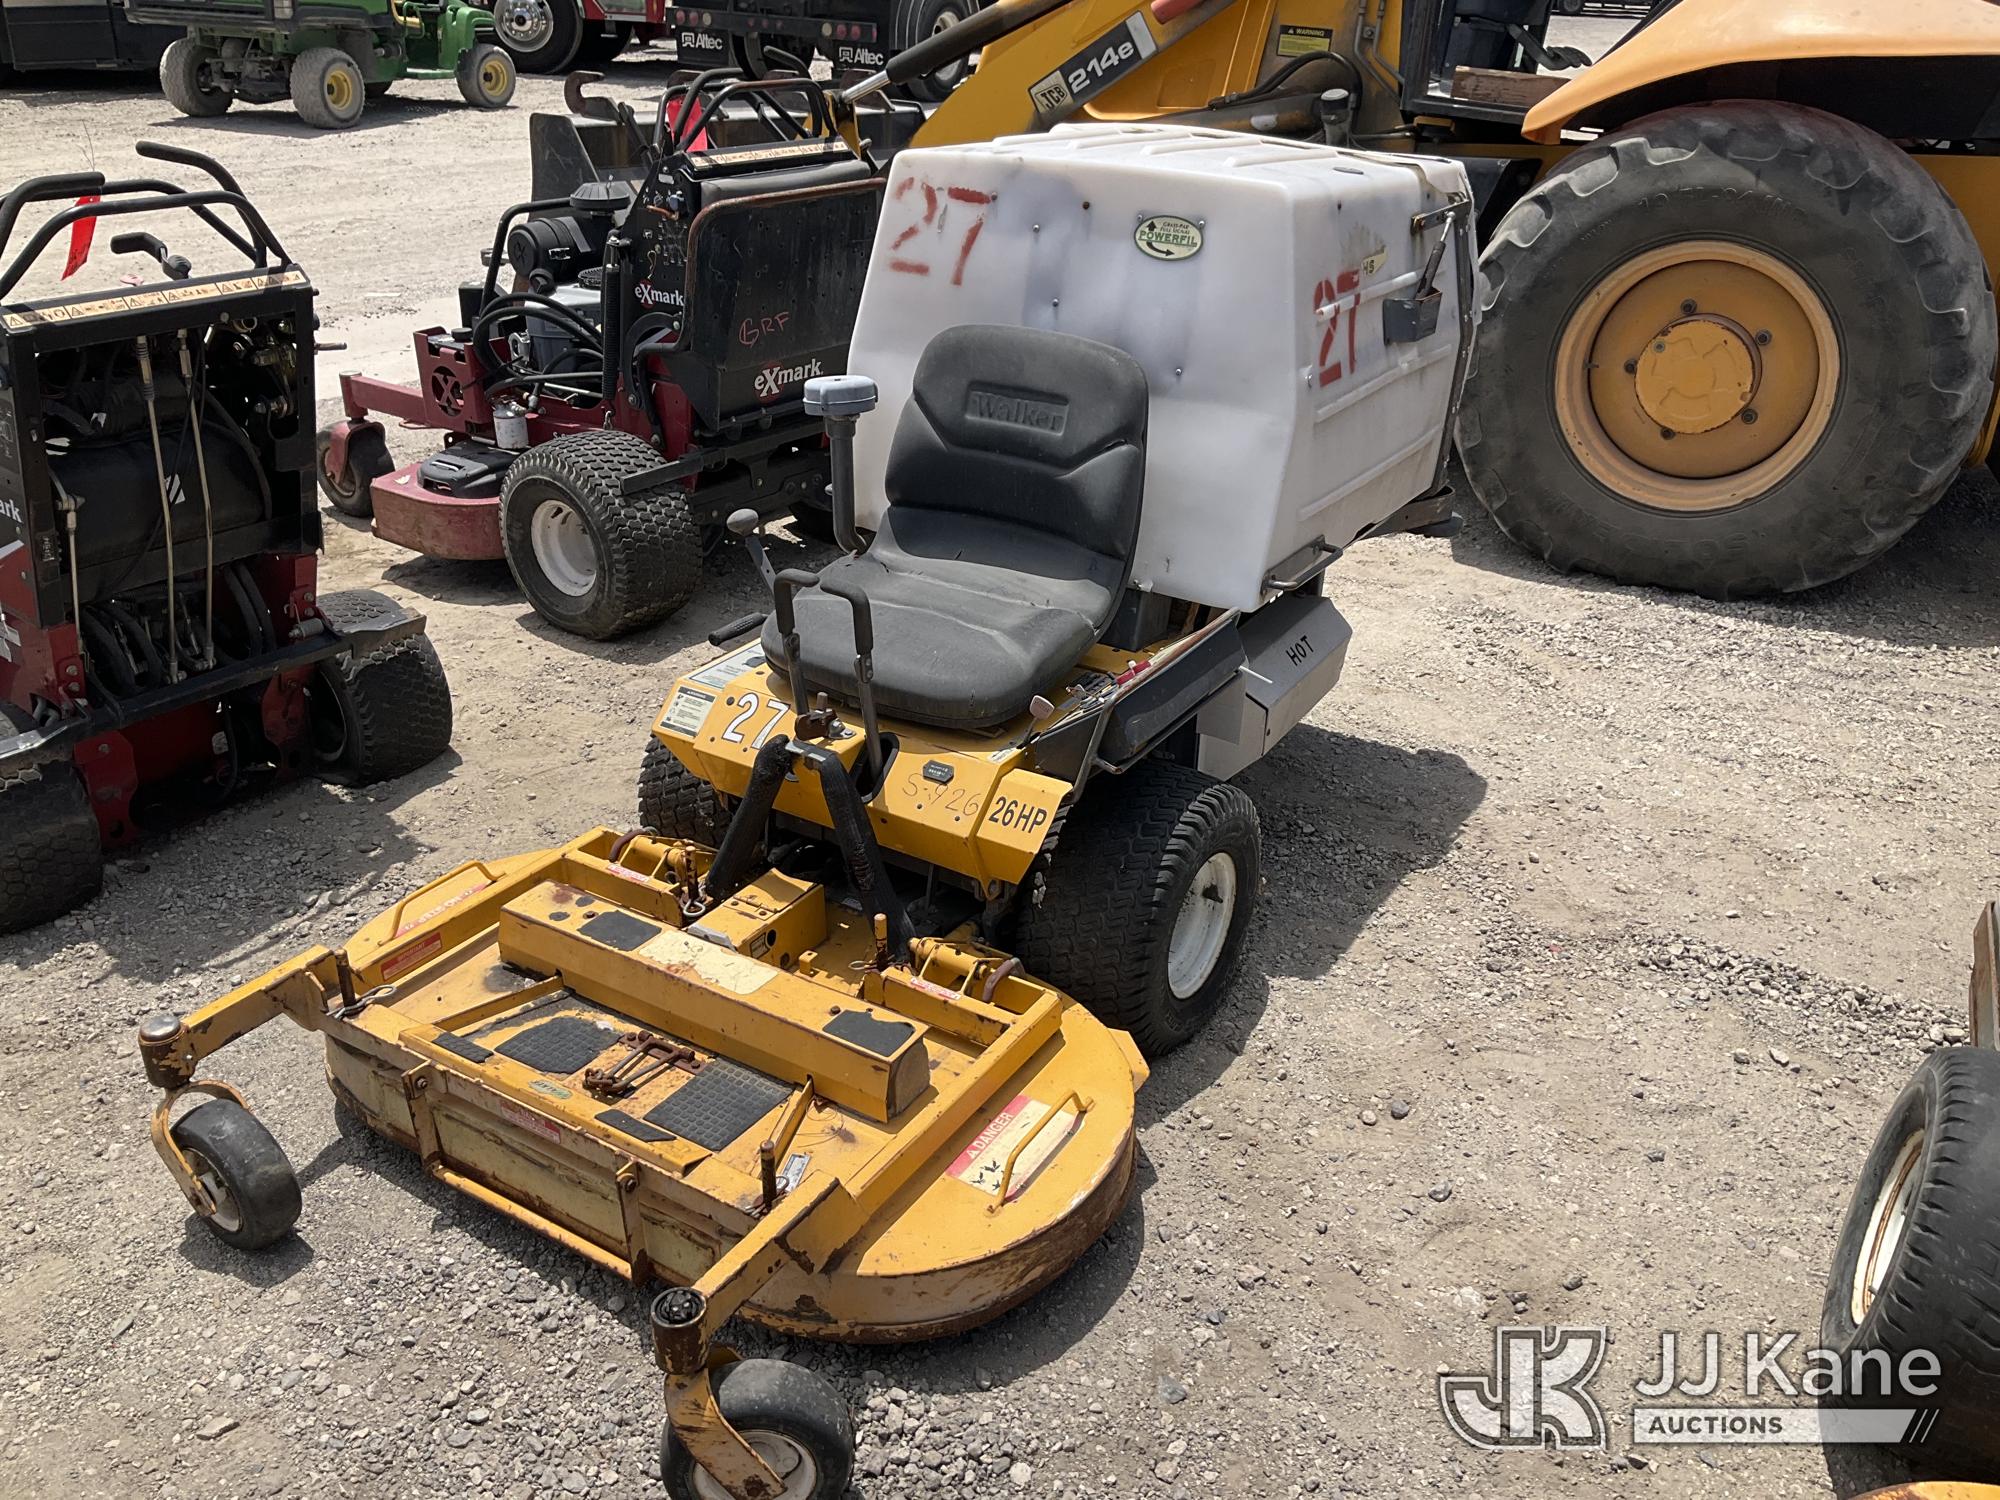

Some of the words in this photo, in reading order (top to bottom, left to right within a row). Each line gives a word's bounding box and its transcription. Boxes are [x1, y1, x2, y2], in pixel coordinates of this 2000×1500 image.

[695, 34, 723, 50] Altec
[1296, 28, 1325, 37] WARNING
[853, 48, 884, 65] Altec
[1068, 42, 1134, 93] 214e
[1040, 86, 1066, 109] JCB
[890, 177, 991, 286] 27
[1139, 230, 1197, 246] POWERFIL
[1314, 268, 1360, 387] 27
[754, 358, 823, 397] eXmark
[1285, 635, 1314, 666] HOT
[721, 692, 791, 750] 27
[988, 796, 1048, 834] 26HP
[978, 1112, 1014, 1150] DANGER
